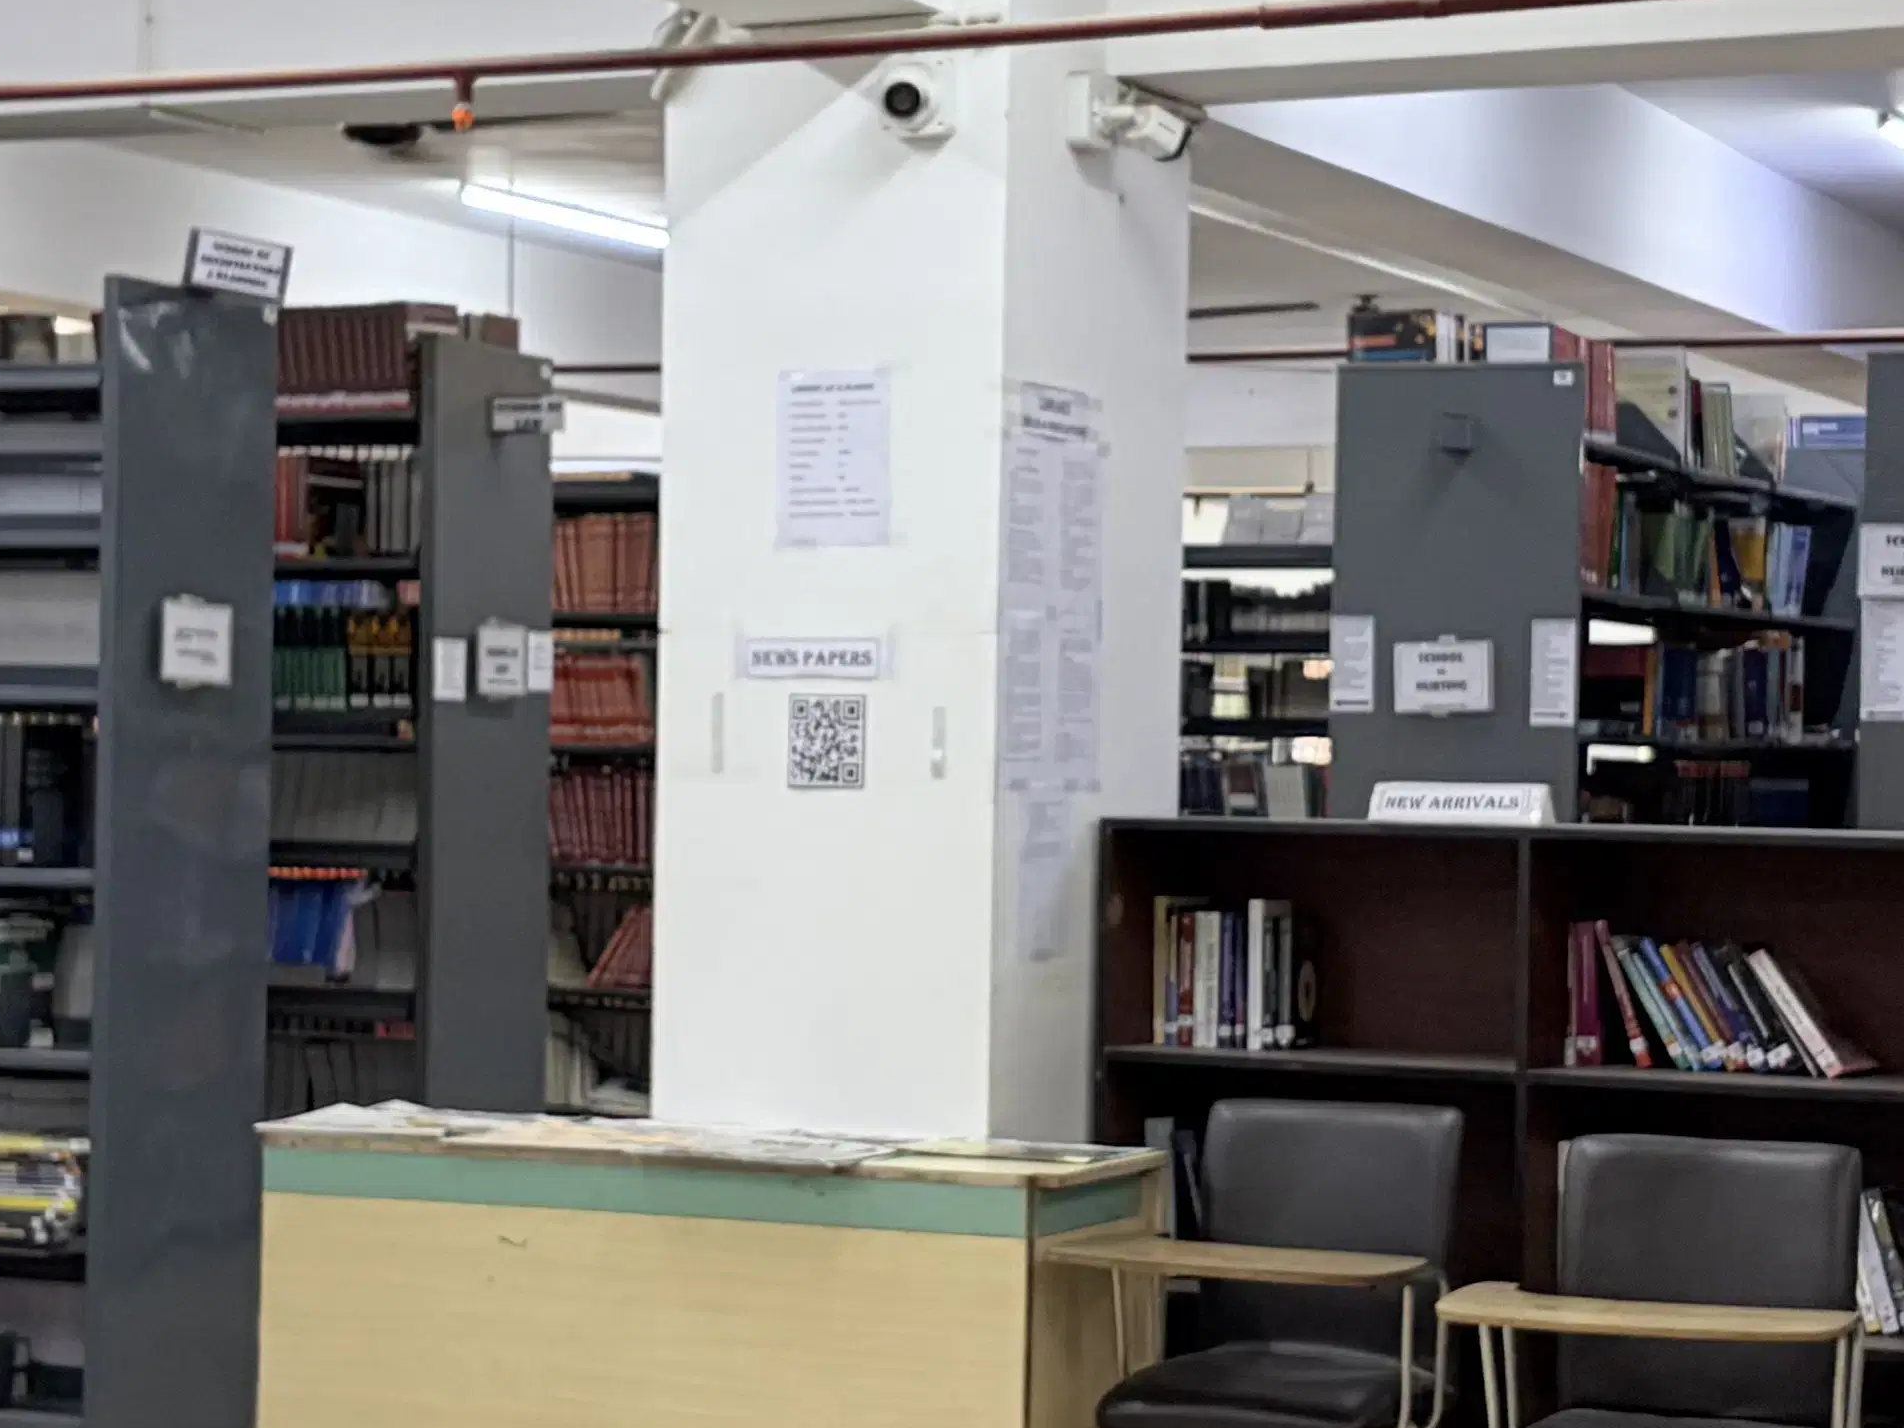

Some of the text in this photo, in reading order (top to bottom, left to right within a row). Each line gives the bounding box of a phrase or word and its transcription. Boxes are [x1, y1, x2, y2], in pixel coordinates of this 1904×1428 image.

[802, 650, 872, 667] PAPERS
[1384, 794, 1520, 811] NEW ARRIVALS
